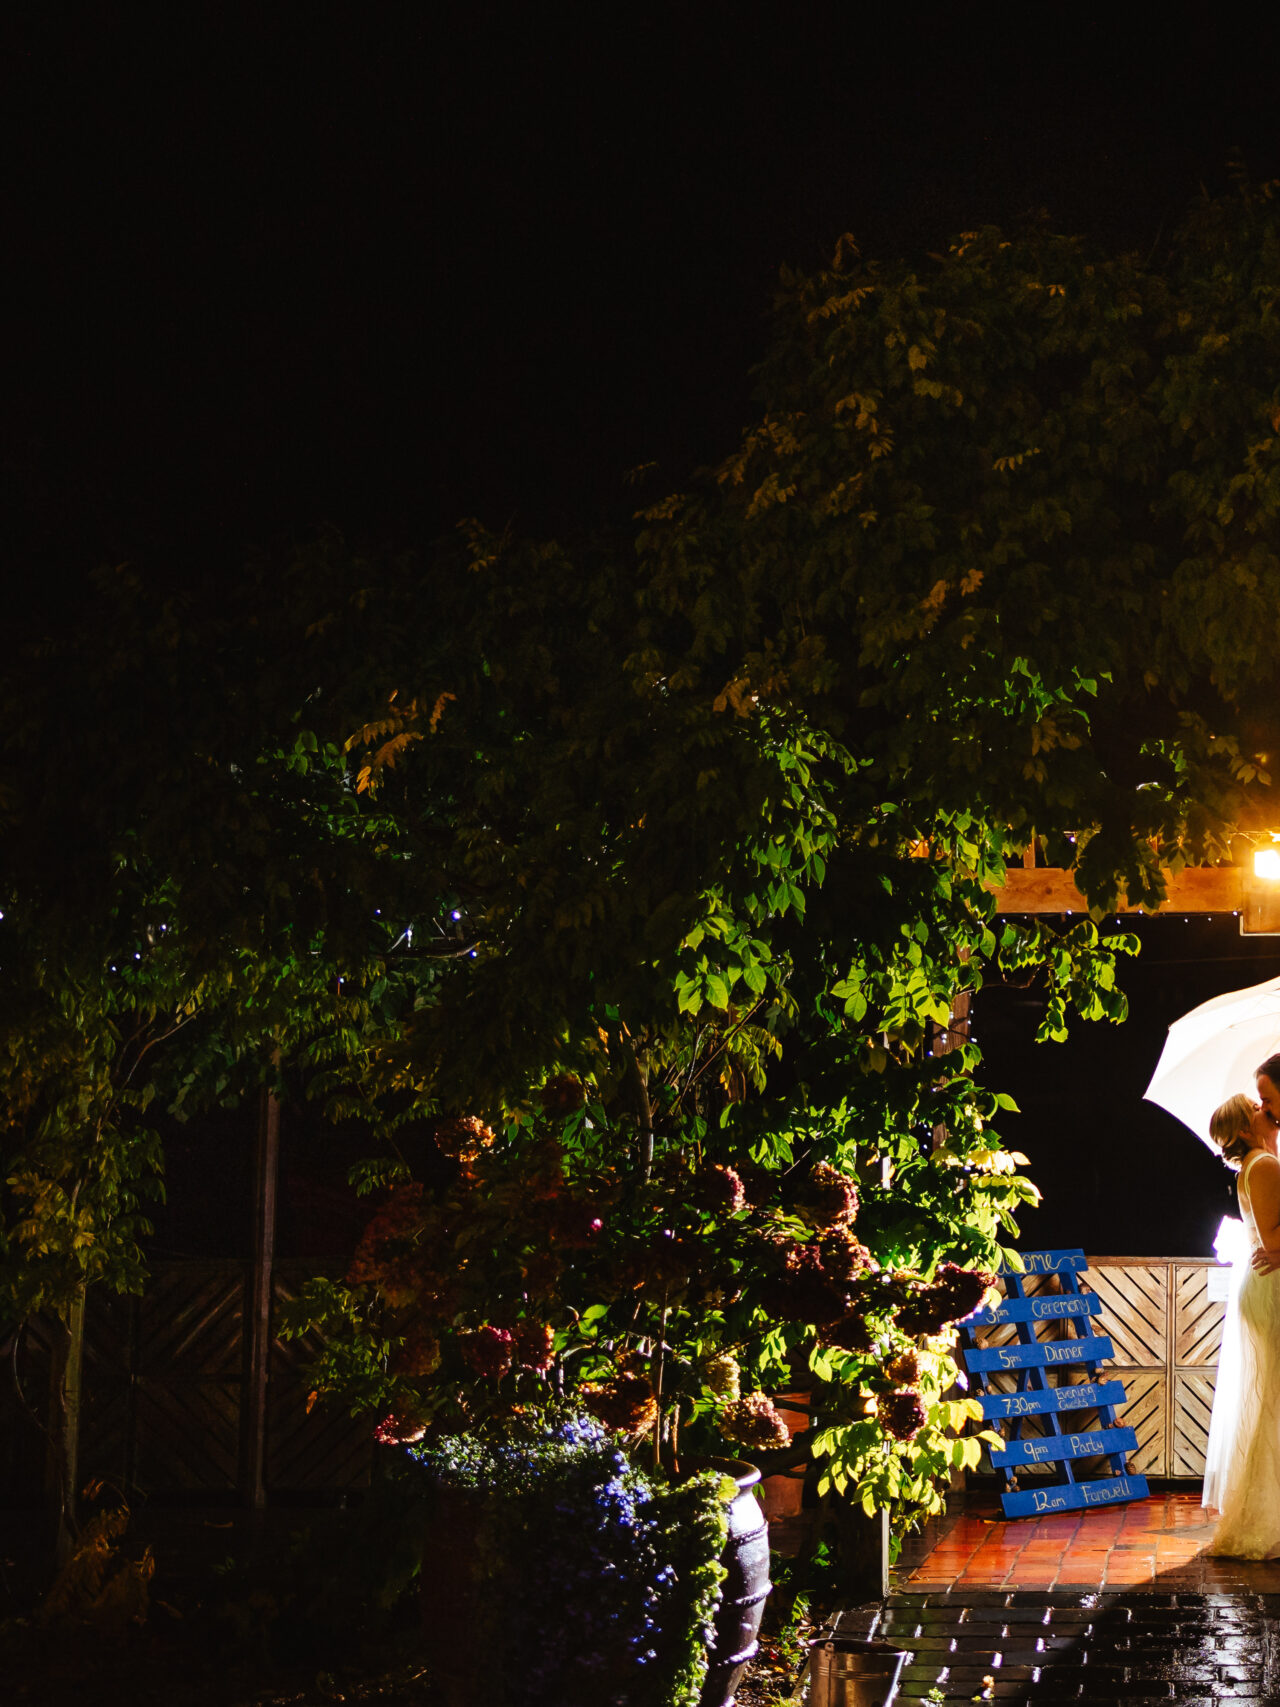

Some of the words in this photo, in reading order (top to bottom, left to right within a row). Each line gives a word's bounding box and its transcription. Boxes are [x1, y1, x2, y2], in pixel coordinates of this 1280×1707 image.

[1032, 1299, 1090, 1318] Ceremony
[998, 1350, 1022, 1368] 5pm
[1044, 1345, 1084, 1362] Dinner
[1055, 1386, 1096, 1402] Evening
[1058, 1400, 1089, 1411] Guests
[1023, 1442, 1049, 1461] 9pm
[1070, 1435, 1105, 1455] Party
[1032, 1491, 1066, 1511] 12am
[1080, 1478, 1133, 1504] Farewell
